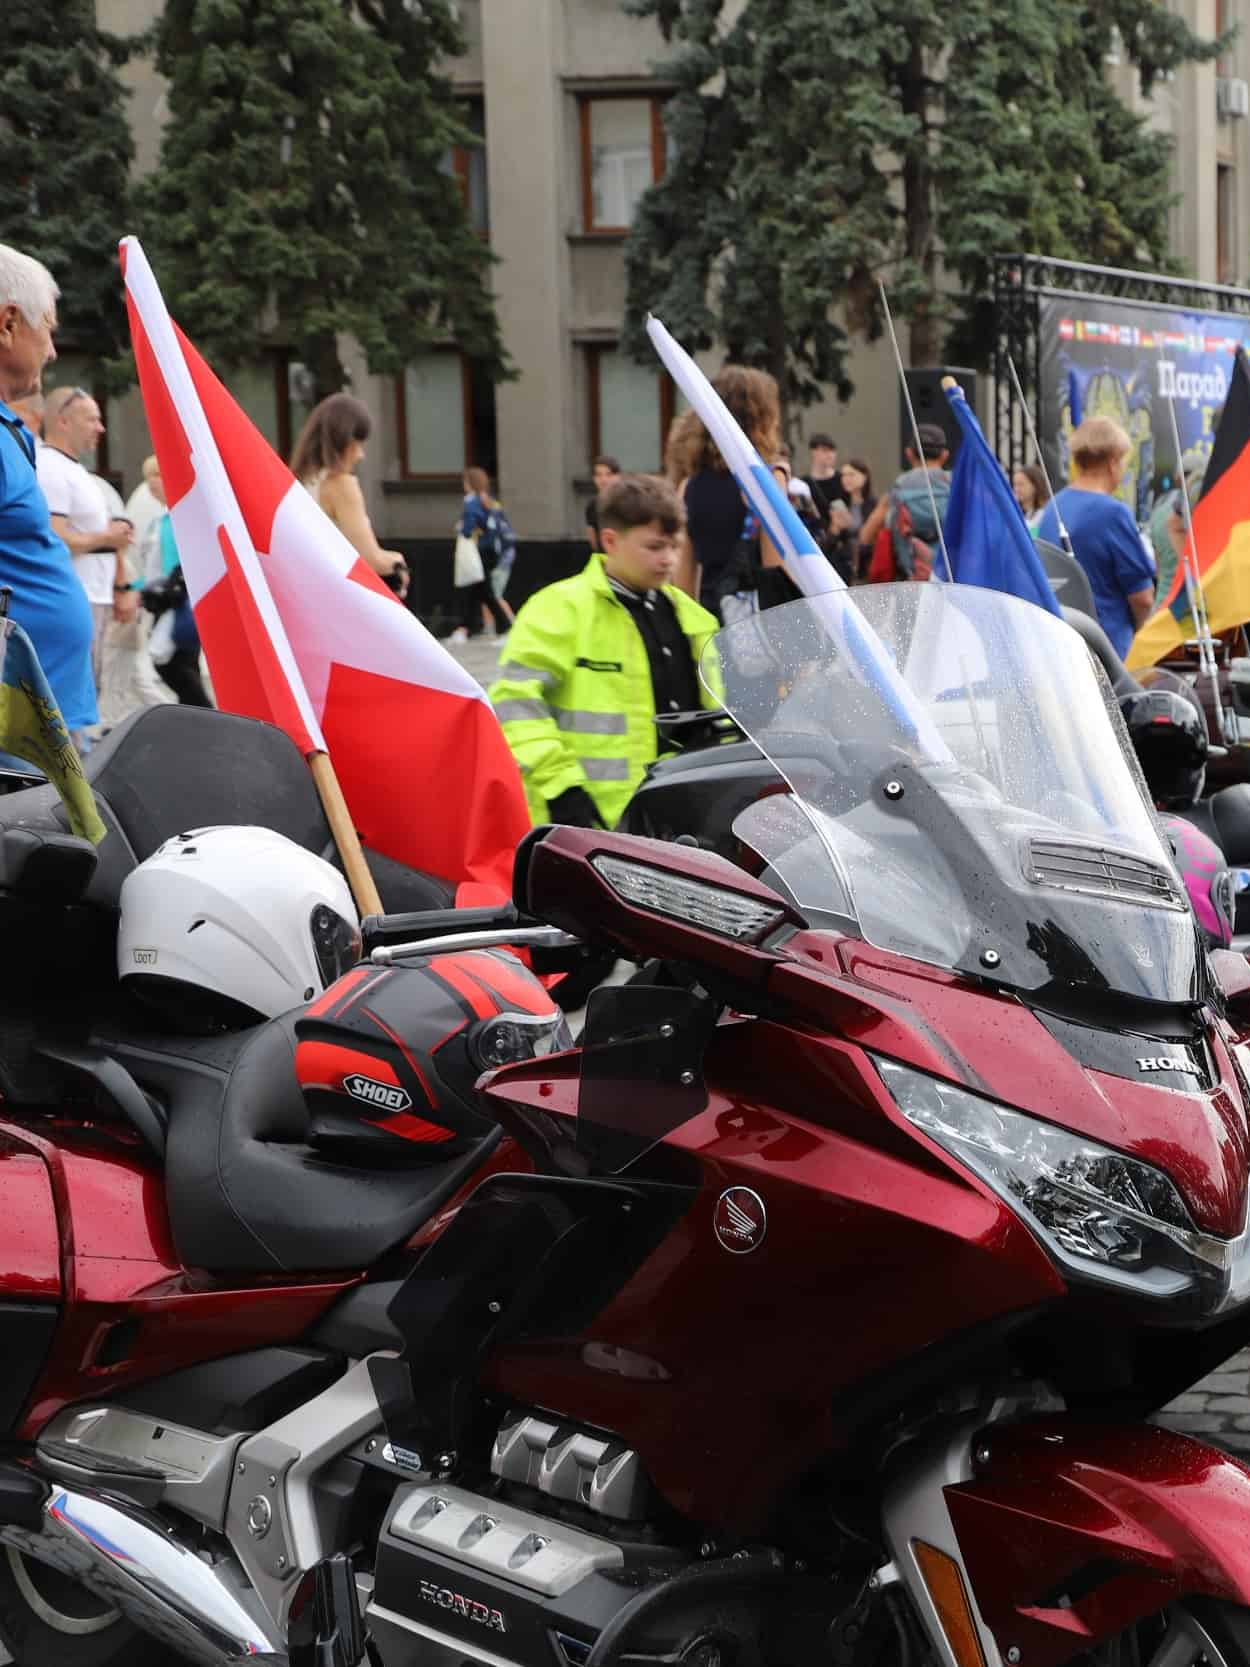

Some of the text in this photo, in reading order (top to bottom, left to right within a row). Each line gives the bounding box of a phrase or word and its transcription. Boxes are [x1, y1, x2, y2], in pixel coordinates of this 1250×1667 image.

[1156, 361, 1227, 410] Парад
[351, 1078, 404, 1108] SHOEI
[418, 1579, 507, 1633] HONDA
